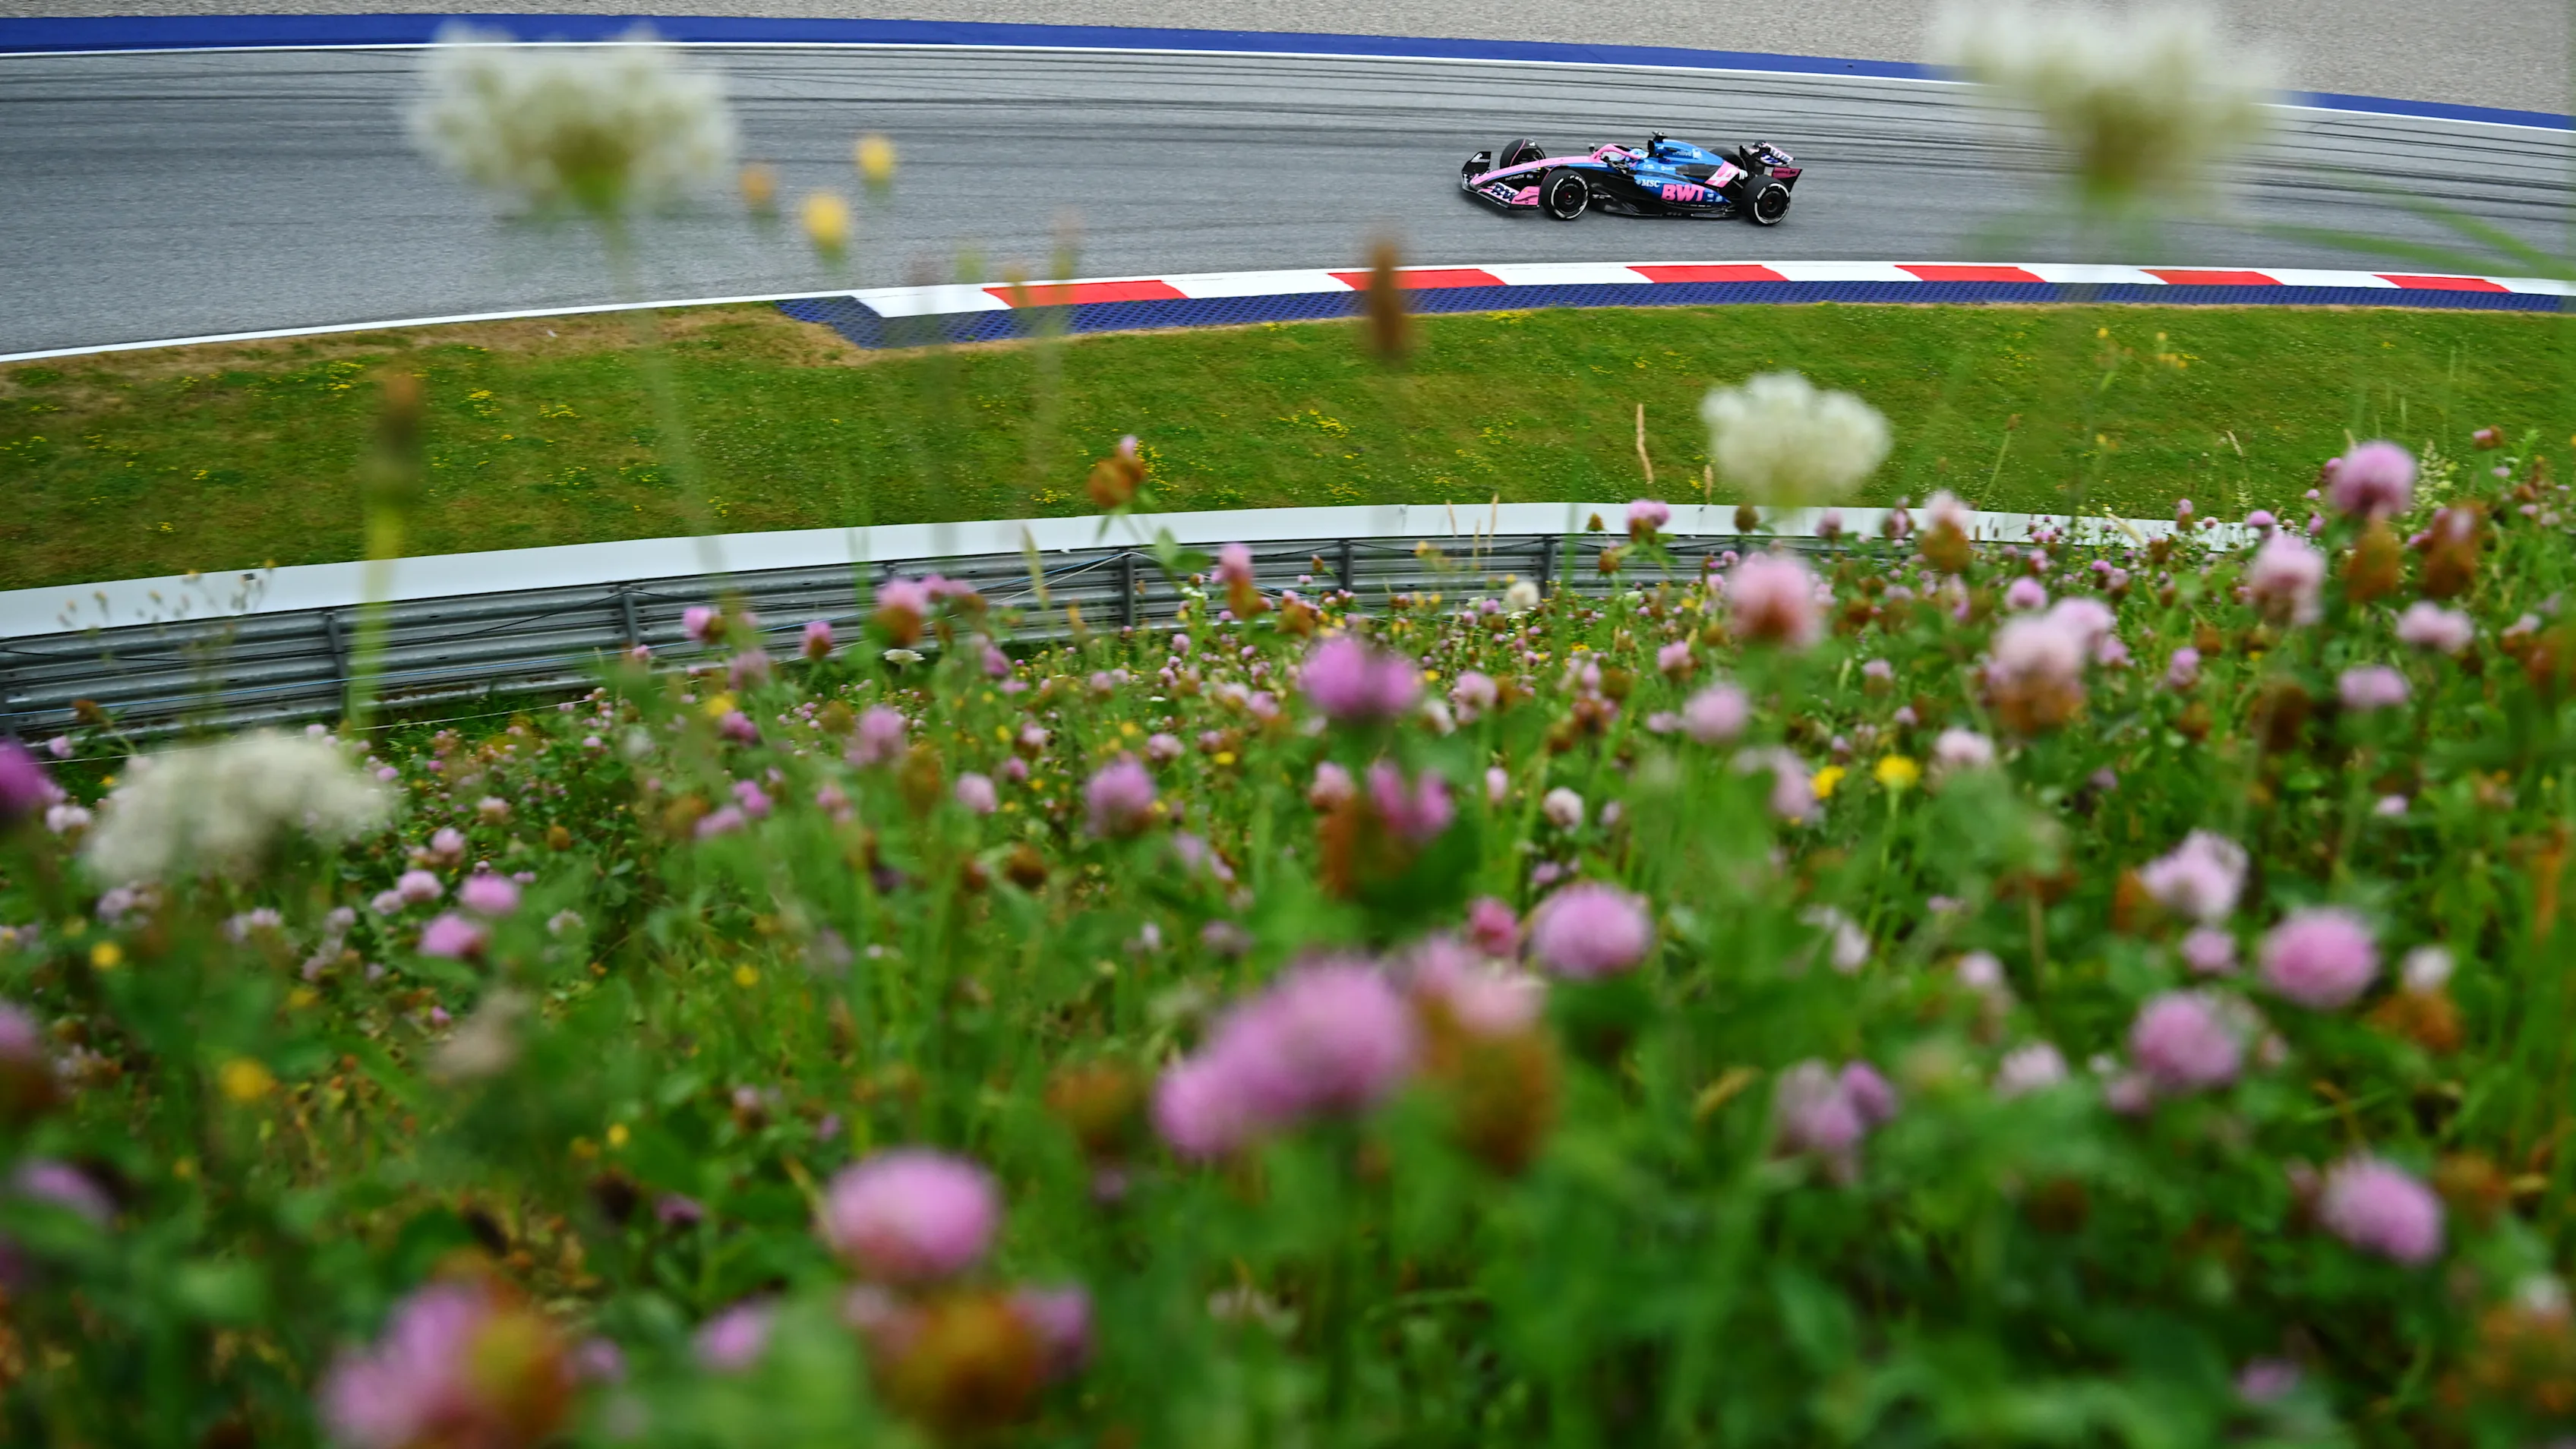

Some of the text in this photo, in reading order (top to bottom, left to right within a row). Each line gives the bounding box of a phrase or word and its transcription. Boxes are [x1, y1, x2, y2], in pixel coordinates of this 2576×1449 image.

[1641, 179, 1660, 188] MSC
[1491, 183, 1515, 202] BW
[1661, 184, 1704, 201] BWT
